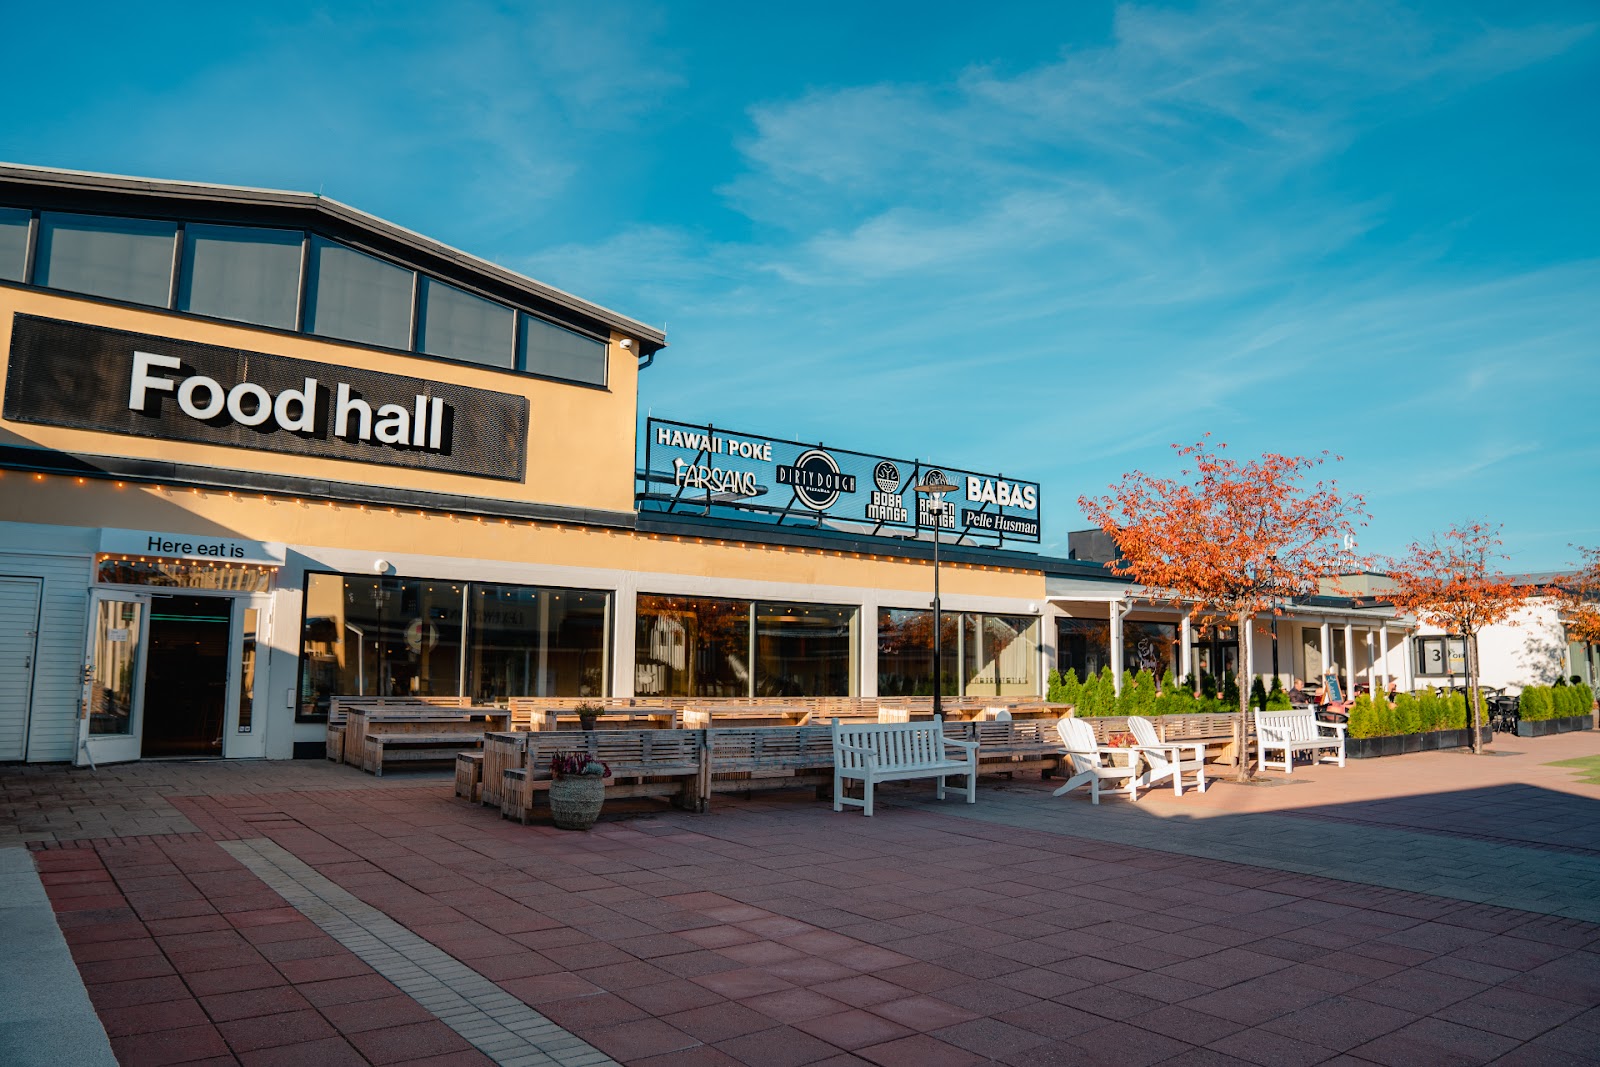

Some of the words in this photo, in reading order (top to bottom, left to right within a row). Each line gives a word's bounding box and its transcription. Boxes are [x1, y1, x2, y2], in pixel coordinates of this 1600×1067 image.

[128, 350, 318, 433] Food
[334, 382, 444, 449] hall
[657, 427, 722, 453] HAWAII
[728, 440, 772, 462] POKÉ
[674, 457, 758, 496] FARSANS
[873, 491, 902, 508] BOBA
[967, 476, 1037, 511] BABAS
[867, 504, 908, 522] MANGA
[919, 498, 955, 516] RAEN
[965, 511, 993, 528] Pelle
[993, 515, 1038, 534] Husman
[147, 536, 193, 554] Here
[197, 543, 226, 557] eat
[230, 543, 245, 558] is
